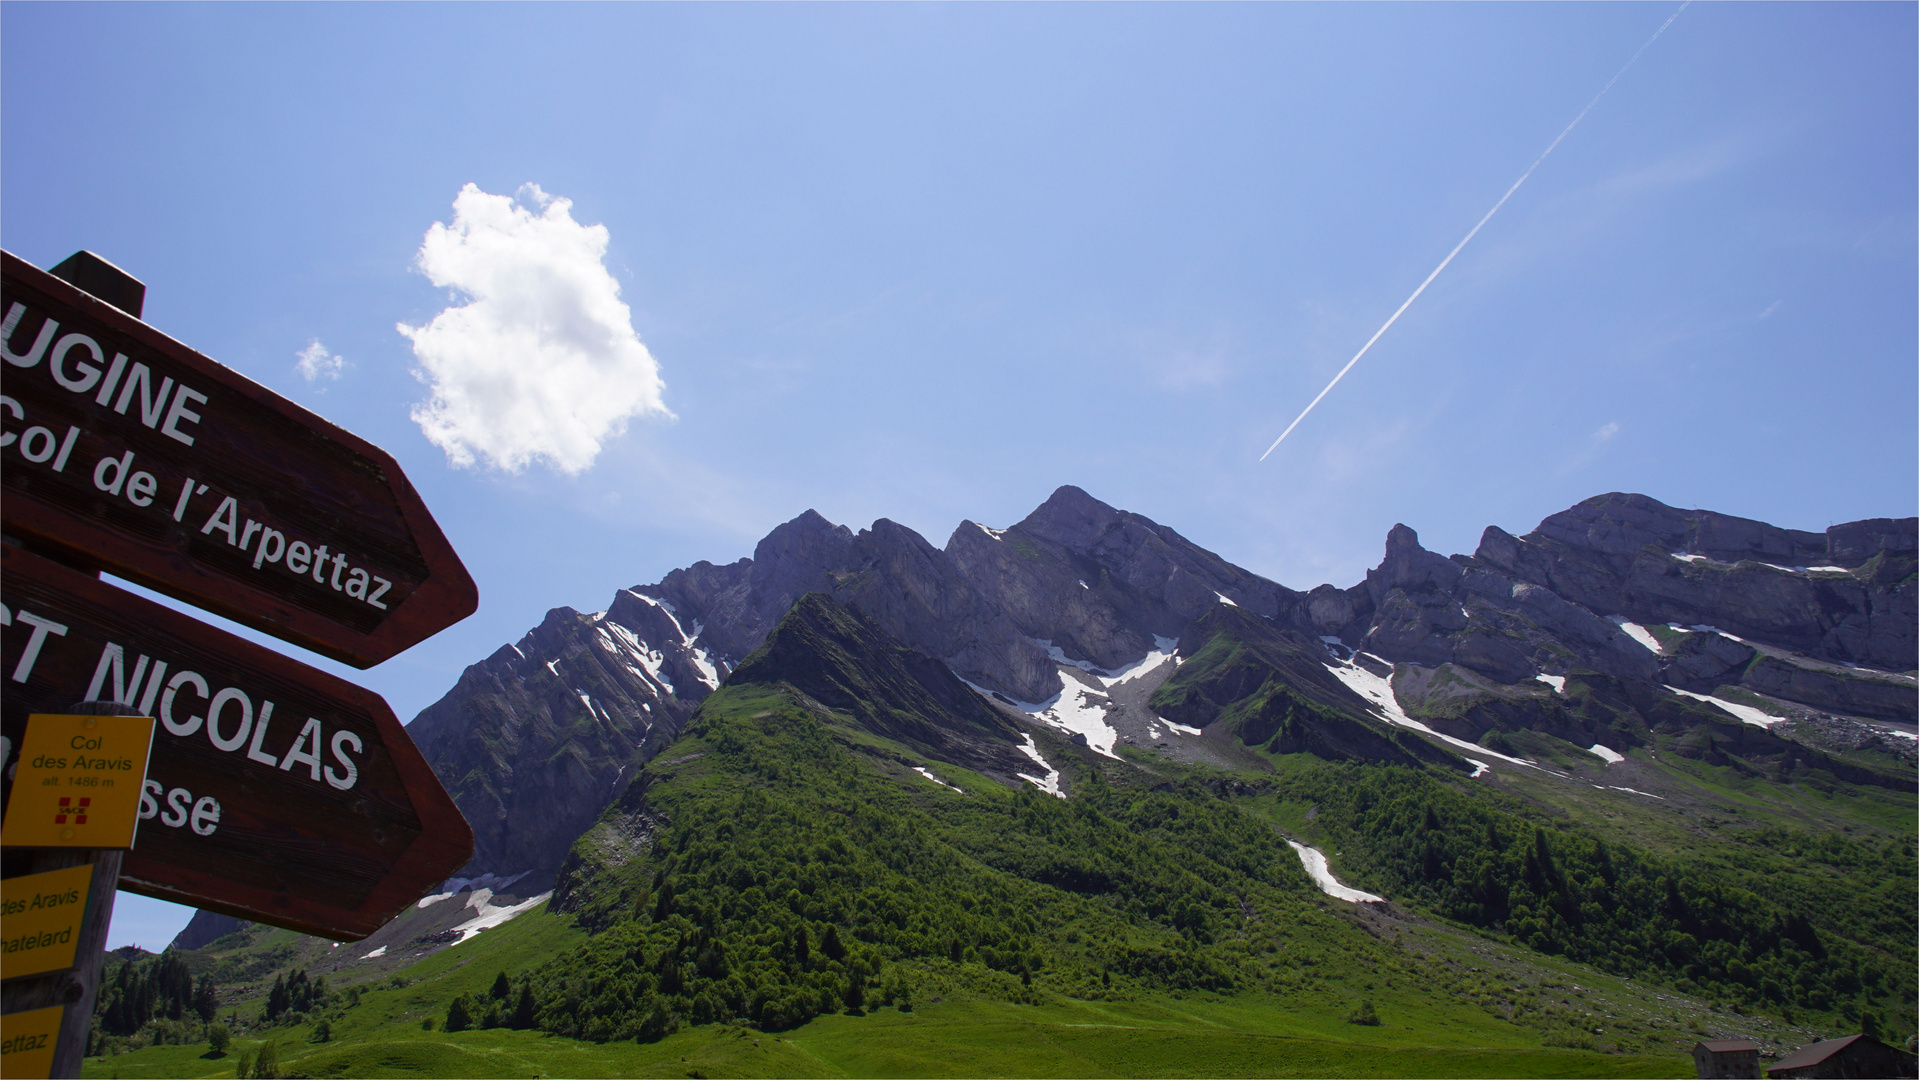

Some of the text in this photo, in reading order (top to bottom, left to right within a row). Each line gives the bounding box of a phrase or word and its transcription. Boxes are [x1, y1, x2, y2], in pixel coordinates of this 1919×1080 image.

[0, 301, 208, 446] UGINE
[0, 394, 80, 473] Col
[93, 450, 158, 508] de
[0, 602, 69, 684] T
[83, 641, 363, 791] NICOLAS
[70, 735, 102, 750] Col
[32, 754, 132, 771] des Aravis
[42, 776, 114, 787] alt. 1486 m
[58, 807, 87, 815] SAVOIE
[137, 779, 220, 836] sse
[0, 889, 79, 916] des Aravis
[0, 1033, 48, 1055] ettaz
